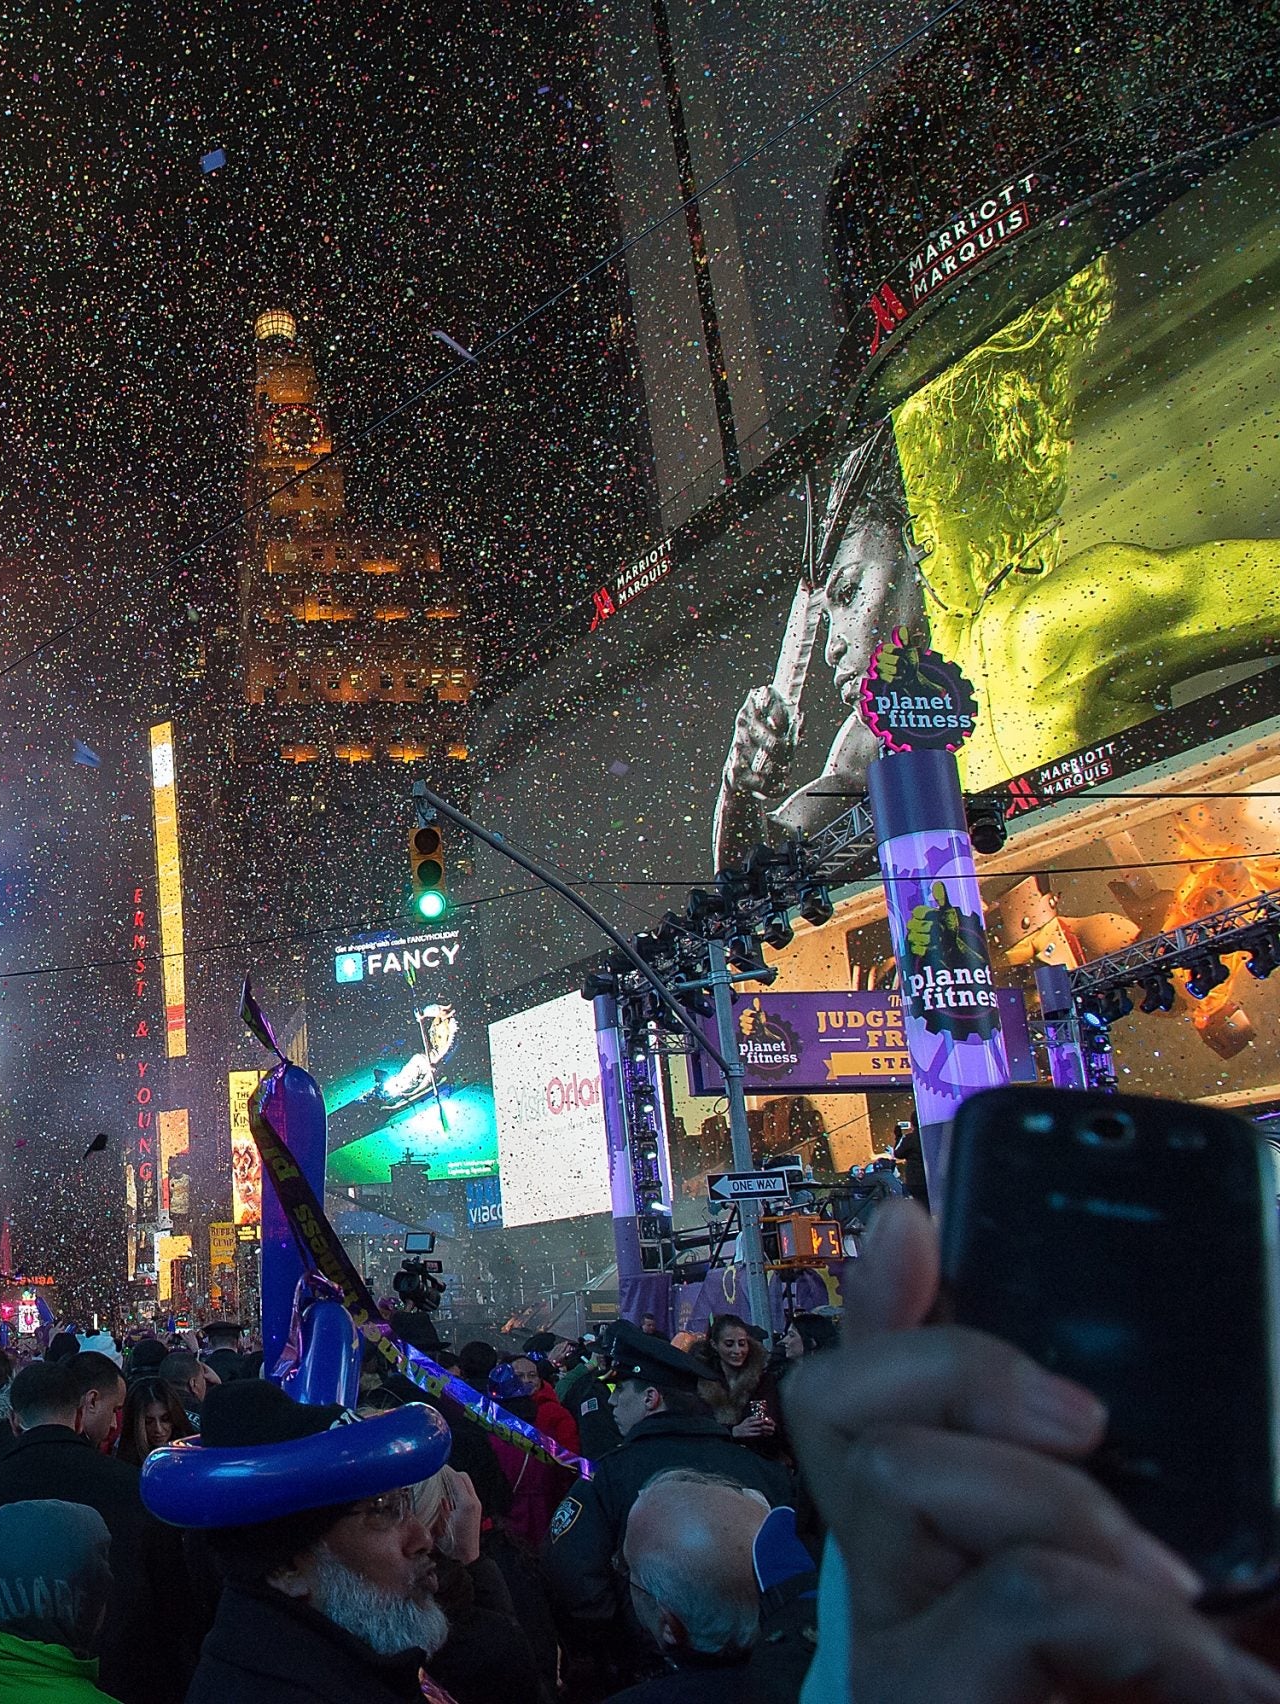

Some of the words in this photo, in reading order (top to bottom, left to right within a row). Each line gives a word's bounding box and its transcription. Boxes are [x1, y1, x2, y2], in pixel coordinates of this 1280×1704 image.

[909, 173, 1035, 281] MARRIOTT
[913, 210, 1023, 300] MARQUIS
[616, 538, 673, 590] MARRIOTT
[618, 559, 669, 605] MARQUIS
[875, 691, 953, 713] planet
[888, 710, 972, 729] fitness
[1040, 741, 1116, 783] MARRIOTT
[1043, 762, 1111, 796] MARQUIS
[132, 888, 148, 998] ERNST
[367, 943, 460, 976] FANCY
[909, 965, 993, 998] planet
[922, 987, 999, 1011] fitnes
[135, 1020, 150, 1038] &
[816, 1010, 903, 1033] JUDGE
[738, 1040, 787, 1056] planet
[746, 1051, 799, 1065] fitness
[871, 1057, 911, 1070] STA
[136, 1061, 154, 1181] YOUNG
[732, 1180, 755, 1192] ONE
[756, 1179, 778, 1191] WAY
[210, 1226, 236, 1237] BUBBA
[212, 1237, 234, 1247] GUMP
